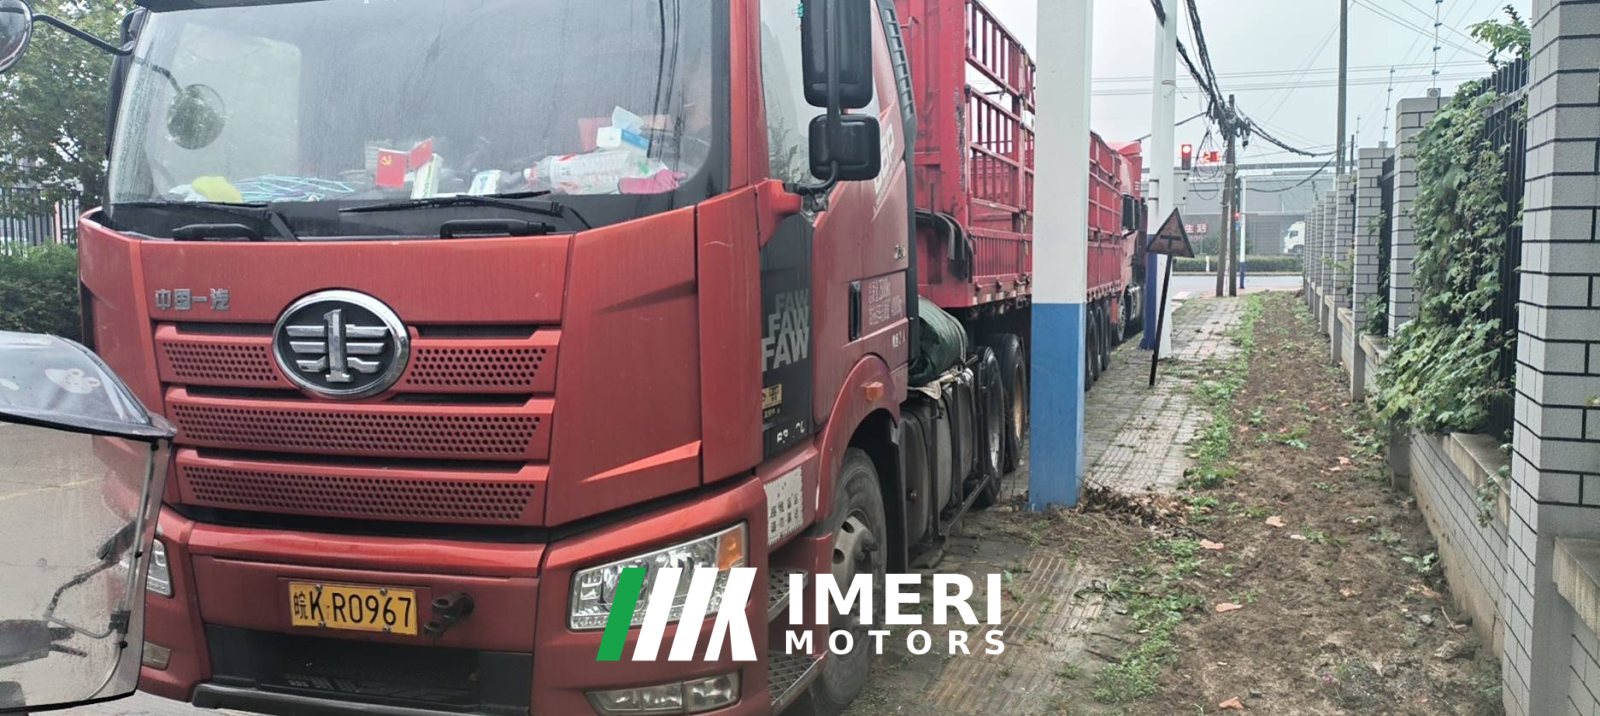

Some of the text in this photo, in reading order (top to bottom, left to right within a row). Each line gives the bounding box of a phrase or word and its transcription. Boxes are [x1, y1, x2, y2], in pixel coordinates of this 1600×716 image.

[155, 288, 230, 311] 中国一汽
[775, 288, 809, 314] FAW
[768, 306, 809, 338] FAW
[761, 327, 809, 372] FAW
